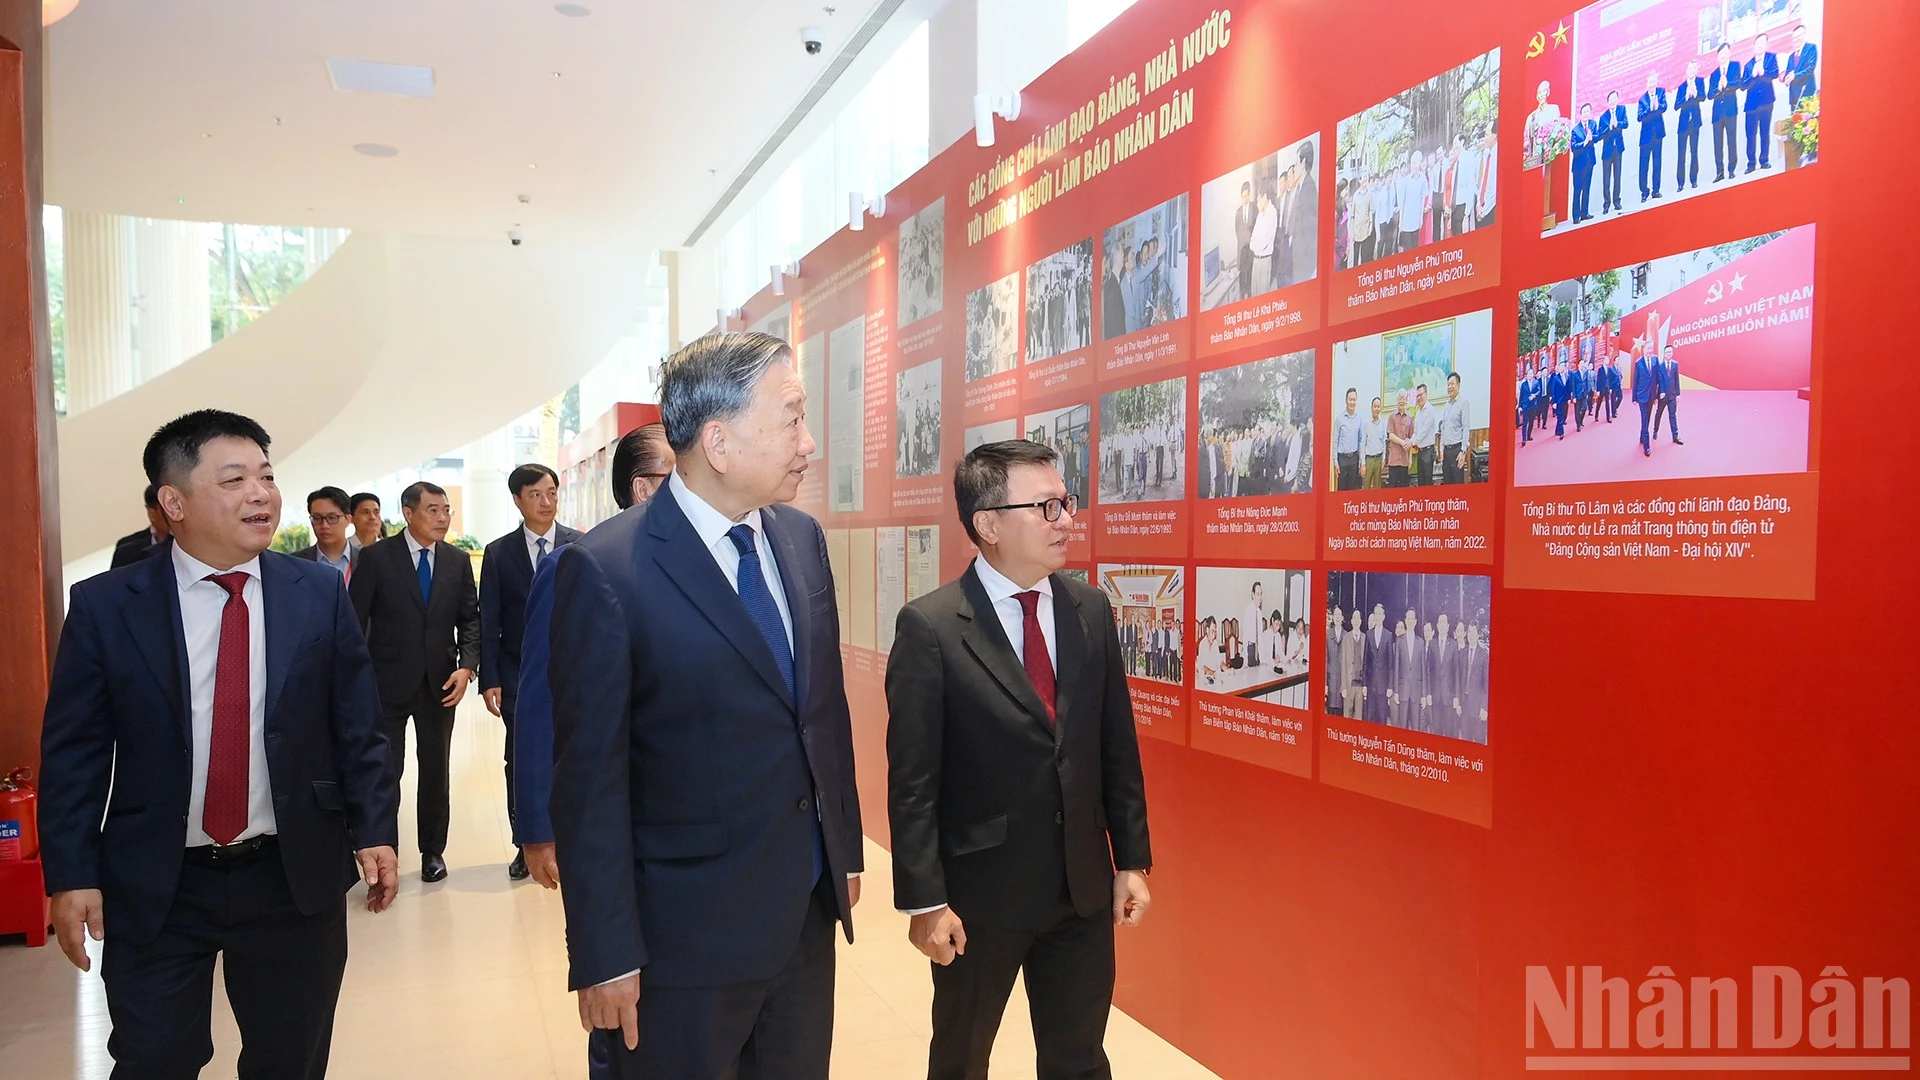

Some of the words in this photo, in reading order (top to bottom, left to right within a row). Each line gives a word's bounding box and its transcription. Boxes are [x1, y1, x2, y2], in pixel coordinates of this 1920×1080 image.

[969, 173, 986, 207] CÁC
[988, 155, 1015, 196] ĐỒNG
[1017, 135, 1035, 176] CHÍ
[1037, 119, 1066, 165] LÃNH
[1069, 100, 1094, 144] ĐẠO
[1098, 75, 1140, 125] ĐẢNG,
[1145, 39, 1177, 96] NHÀ
[1182, 10, 1231, 72] NƯỚC
[968, 208, 982, 246] VỚI
[984, 195, 1017, 238] NHỮNG
[1019, 172, 1052, 219] NGƯỜI
[1055, 156, 1080, 198] LÀM
[1084, 138, 1110, 181] BÁO
[1114, 112, 1154, 164] NHÂN
[1159, 89, 1194, 139] DÂN
[1358, 272, 1373, 287] Tổng
[1376, 270, 1383, 282] Bí
[1384, 268, 1396, 279] thư
[1397, 257, 1423, 276] Nguyễn
[1425, 254, 1439, 268] Phú
[1442, 249, 1463, 265] Trọng
[1348, 294, 1364, 307] thăm
[1366, 291, 1378, 302] Báo
[1380, 285, 1397, 299] Nhân
[1399, 281, 1415, 294] Dân,
[1417, 275, 1435, 290] ngày
[1437, 263, 1474, 284] 9/6/2012.
[1673, 332, 1700, 348] QUANG
[1701, 329, 1725, 341] VINH
[1727, 319, 1764, 336] MUÔN
[1767, 306, 1809, 327] NĂM!
[1343, 500, 1359, 516] Tổng
[1361, 501, 1367, 513] Bí
[1369, 501, 1380, 513] thư
[1381, 498, 1407, 515] Nguyễn
[1409, 500, 1422, 512] Phú
[1424, 500, 1445, 514] Trọng
[1447, 498, 1469, 512] thăm,
[1522, 501, 1544, 518] Tổng
[1546, 502, 1555, 516] Bí
[1557, 502, 1574, 515] thư
[1576, 501, 1586, 515] Tô
[1589, 501, 1610, 514] Lâm
[1613, 500, 1624, 514] và
[1627, 499, 1645, 513] các
[1648, 497, 1675, 516] đồng
[1679, 497, 1696, 512] chí
[1699, 497, 1724, 512] lãnh
[1727, 496, 1749, 515] đạo
[1753, 495, 1791, 514] Đảng,
[1350, 519, 1365, 531] chúc
[1367, 520, 1386, 533] mừng
[1388, 519, 1402, 530] Báo
[1403, 519, 1421, 530] Nhân
[1424, 518, 1438, 529] Dân
[1441, 518, 1459, 529] nhân
[1532, 523, 1550, 536] Nhà
[1553, 522, 1576, 536] nước
[1578, 522, 1592, 538] dự
[1594, 519, 1605, 535] Lễ
[1608, 524, 1619, 535] ra
[1621, 521, 1641, 535] mắt
[1643, 521, 1673, 538] Trang
[1676, 521, 1708, 537] thông
[1712, 520, 1726, 534] tin
[1730, 519, 1756, 536] điện
[1760, 518, 1774, 534] tử
[1329, 537, 1344, 550] Ngày
[1346, 536, 1357, 548] Báo
[1359, 537, 1369, 548] chí
[1370, 537, 1385, 548] cách
[1388, 537, 1407, 551] mạng
[1408, 536, 1422, 551] Việt
[1424, 537, 1443, 550] Nam,
[1445, 536, 1461, 548] năm
[1464, 536, 1487, 548] 2022.
[1545, 543, 1573, 559] "Đảng
[1576, 542, 1600, 559] Cộng
[1603, 543, 1620, 556] sản
[1623, 542, 1642, 560] Việt
[1645, 543, 1670, 556] Nam
[1682, 542, 1701, 560] Đại
[1704, 543, 1722, 560] hội
[1327, 728, 1338, 741] Thủ
[1339, 730, 1357, 746] tướng
[1359, 735, 1382, 750] Nguyễn
[1384, 740, 1395, 752] Tấn
[1397, 743, 1414, 759] Dũng
[1417, 747, 1436, 764] thăm,
[1439, 750, 1452, 764] làm
[1454, 756, 1469, 770] việc
[1471, 759, 1483, 772] với
[1352, 750, 1364, 762] Báo
[1366, 753, 1382, 766] Nhân
[1384, 758, 1399, 772] Dân,
[1400, 761, 1419, 778] tháng
[1421, 765, 1449, 782] 2/2010.
